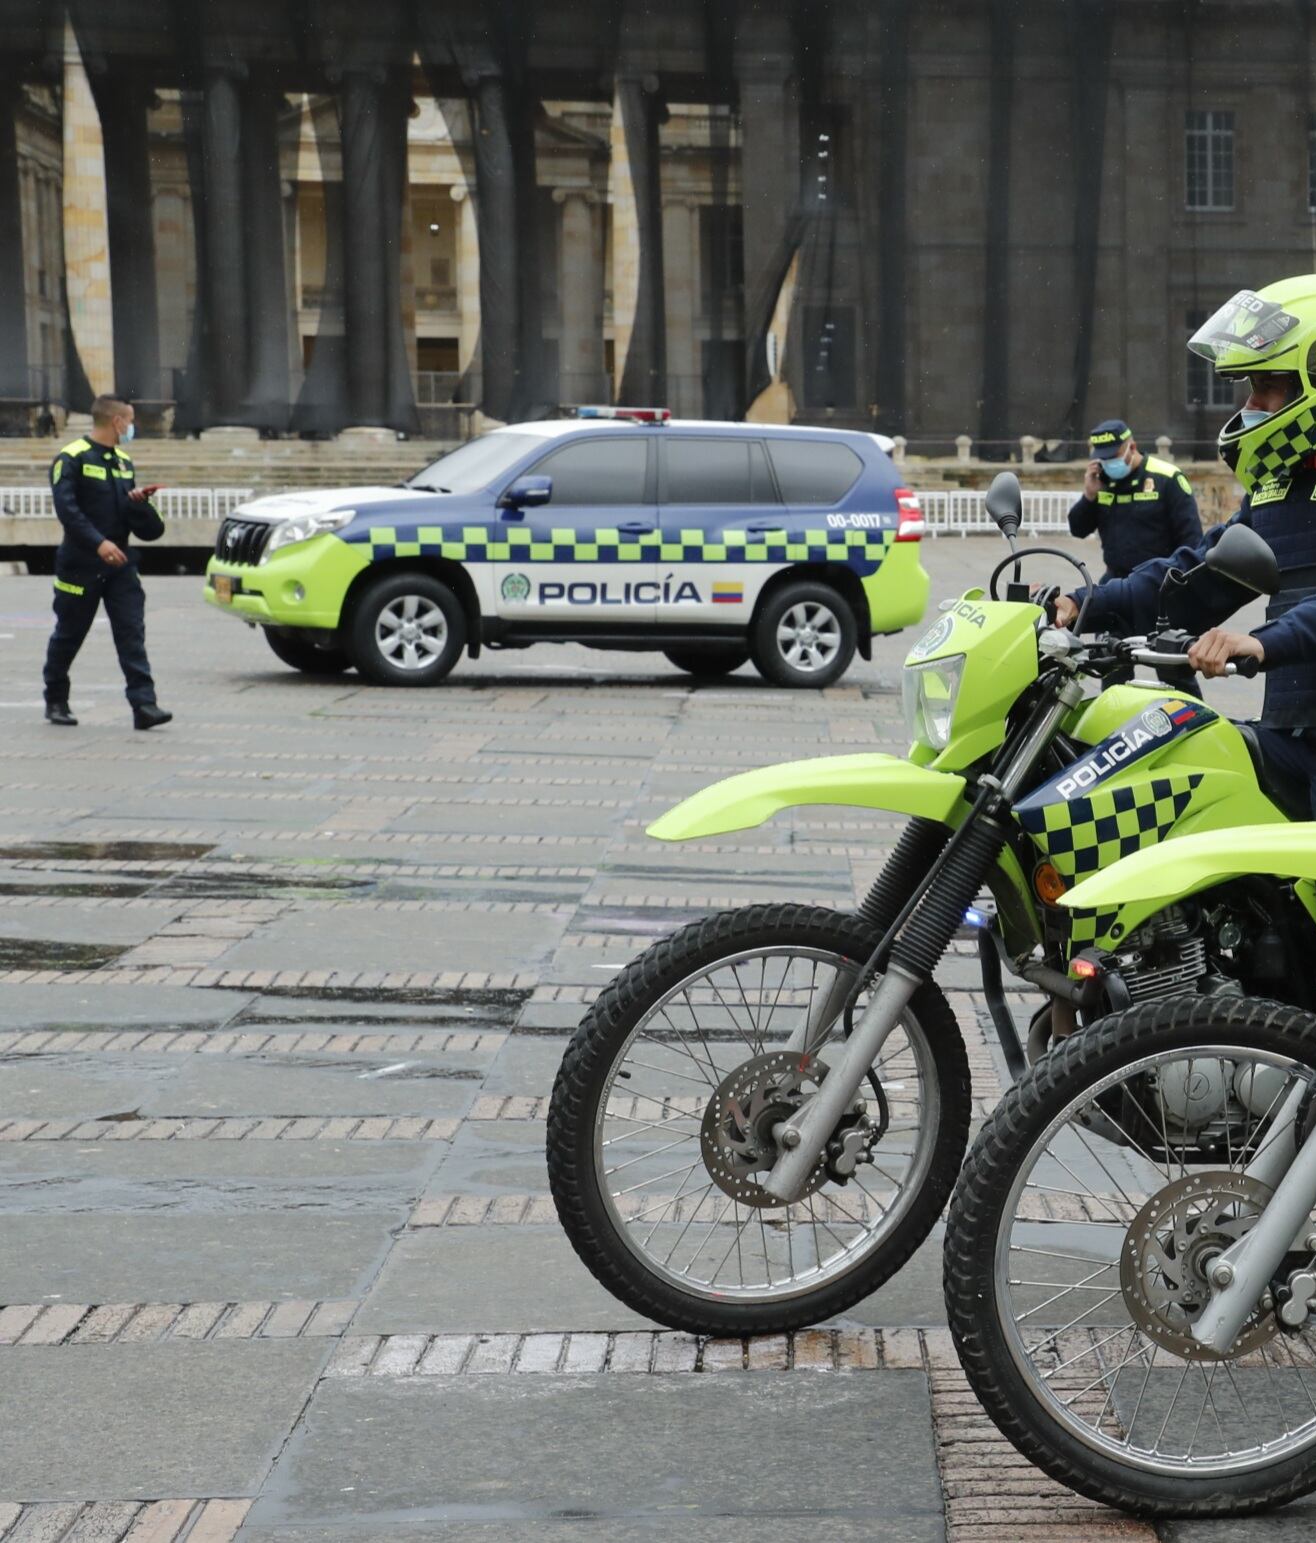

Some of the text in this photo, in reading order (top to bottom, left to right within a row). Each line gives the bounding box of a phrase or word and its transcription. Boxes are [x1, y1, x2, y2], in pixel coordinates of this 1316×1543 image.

[827, 513, 880, 528] 00-0017
[538, 572, 703, 605] POLICÍA
[953, 601, 986, 629] ICÍA
[1055, 728, 1154, 800] POLICÍA
